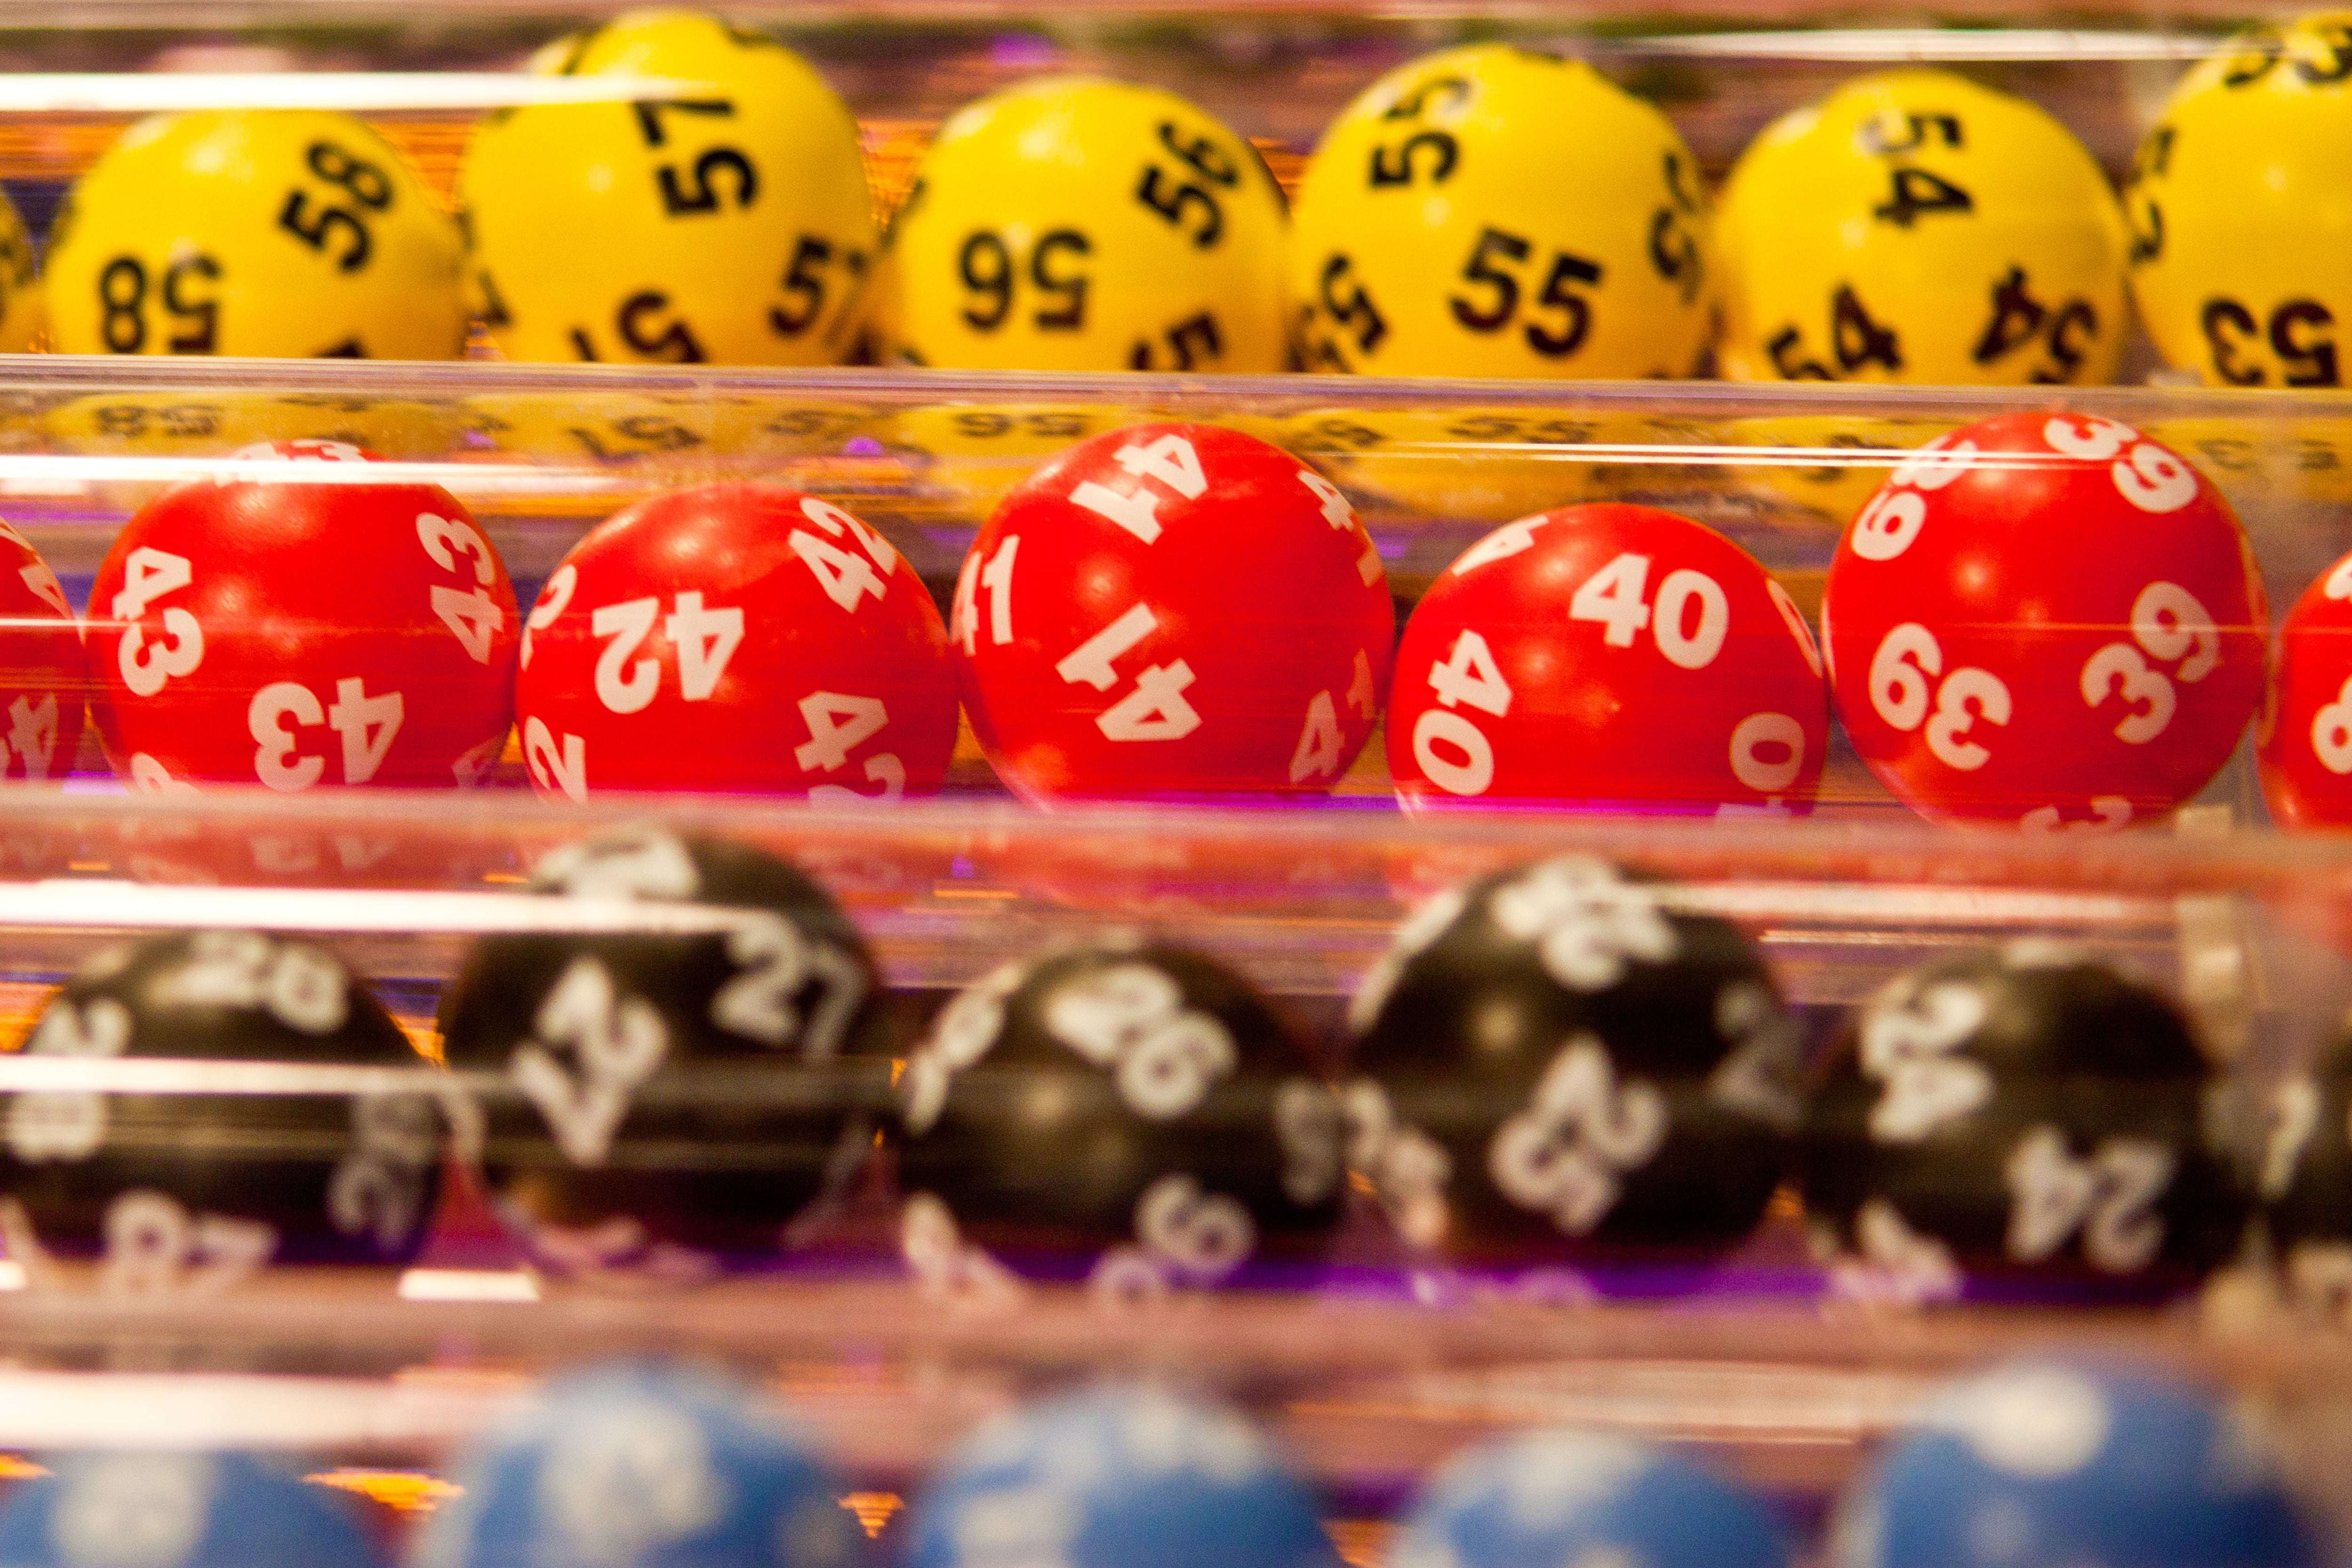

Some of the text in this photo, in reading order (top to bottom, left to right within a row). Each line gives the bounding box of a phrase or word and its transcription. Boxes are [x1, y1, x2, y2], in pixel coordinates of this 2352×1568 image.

[631, 96, 761, 217] 57
[1133, 119, 1242, 250] 56
[1368, 74, 1475, 189] 55
[1852, 110, 1976, 230] 54
[277, 139, 396, 275] 58
[98, 252, 223, 356] 58
[958, 226, 1094, 334] 56
[1446, 225, 1605, 361] 55
[1764, 278, 1905, 380] 54
[1970, 263, 2100, 384] 54
[2199, 294, 2345, 388] 53
[1067, 432, 1209, 546] 41
[2042, 416, 2200, 514] 39
[415, 511, 505, 666] 43
[787, 496, 898, 614] 42
[950, 533, 1021, 658] 41
[1568, 552, 1731, 670] 40
[111, 544, 206, 698] 43
[591, 590, 746, 714] 42
[1054, 601, 1204, 743] 41
[2079, 580, 2223, 746] 39
[246, 675, 405, 795] 43
[792, 690, 908, 808] 42
[1425, 627, 1514, 797] 40
[1868, 621, 2014, 772] 39
